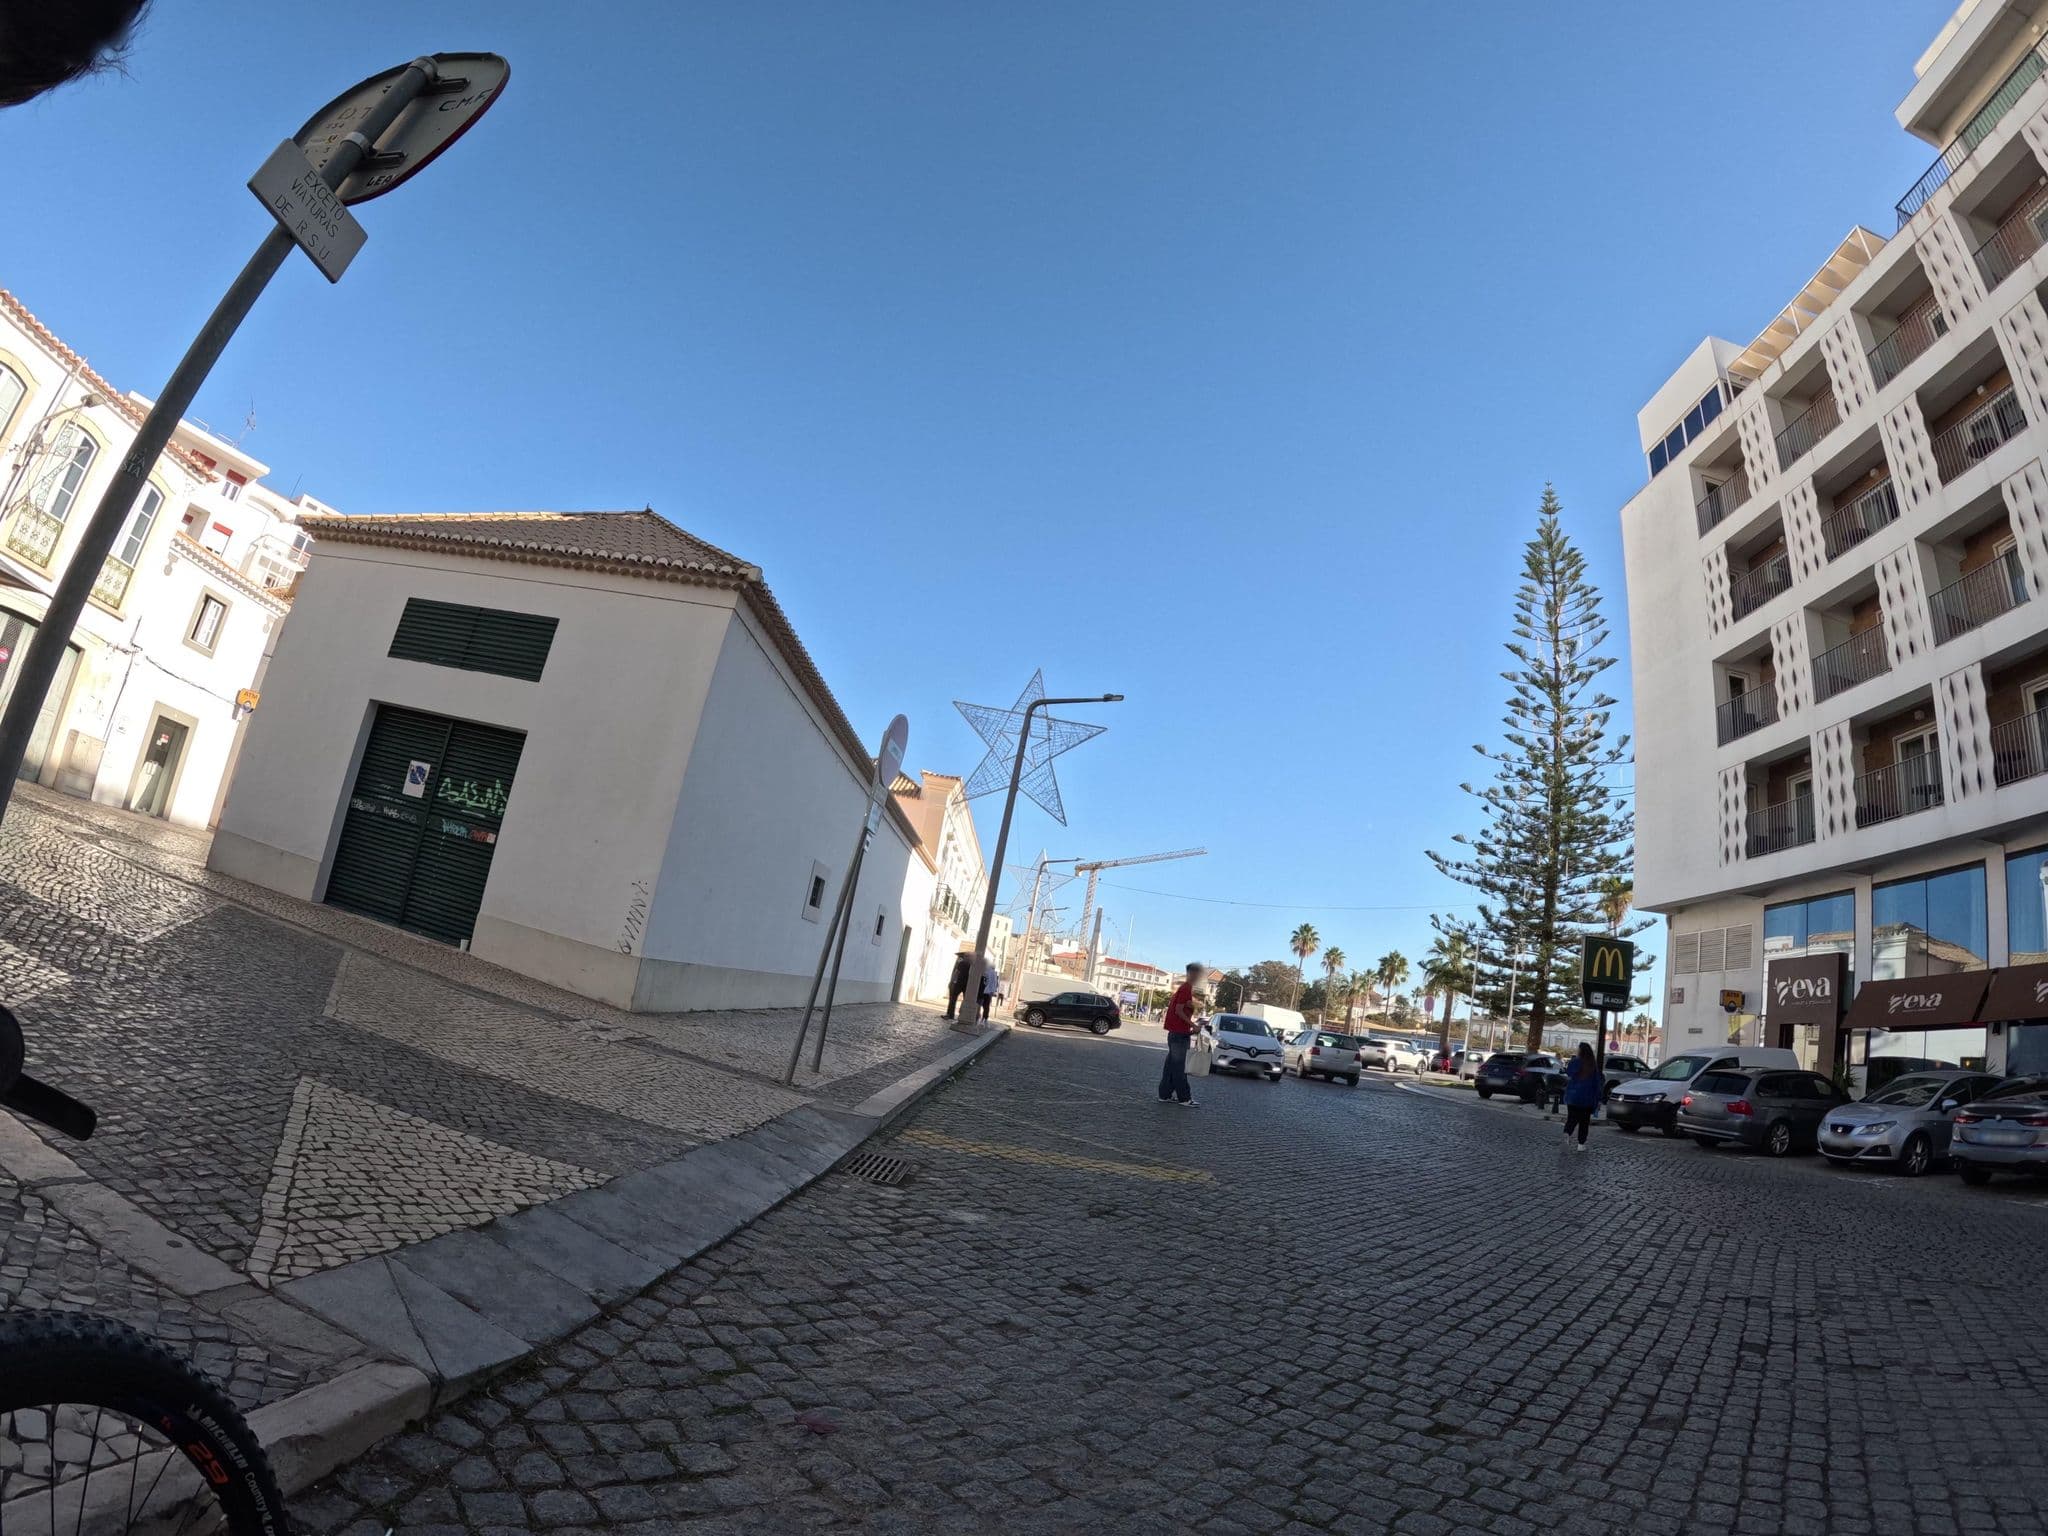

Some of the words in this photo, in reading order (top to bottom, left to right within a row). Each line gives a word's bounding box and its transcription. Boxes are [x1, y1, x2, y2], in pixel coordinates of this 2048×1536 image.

[274, 194, 294, 218] DE
[291, 178, 339, 238] VIATURAS
[303, 170, 345, 221] EXCETO
[200, 1415, 249, 1469] MICHELIN
[245, 1471, 268, 1512] Country
